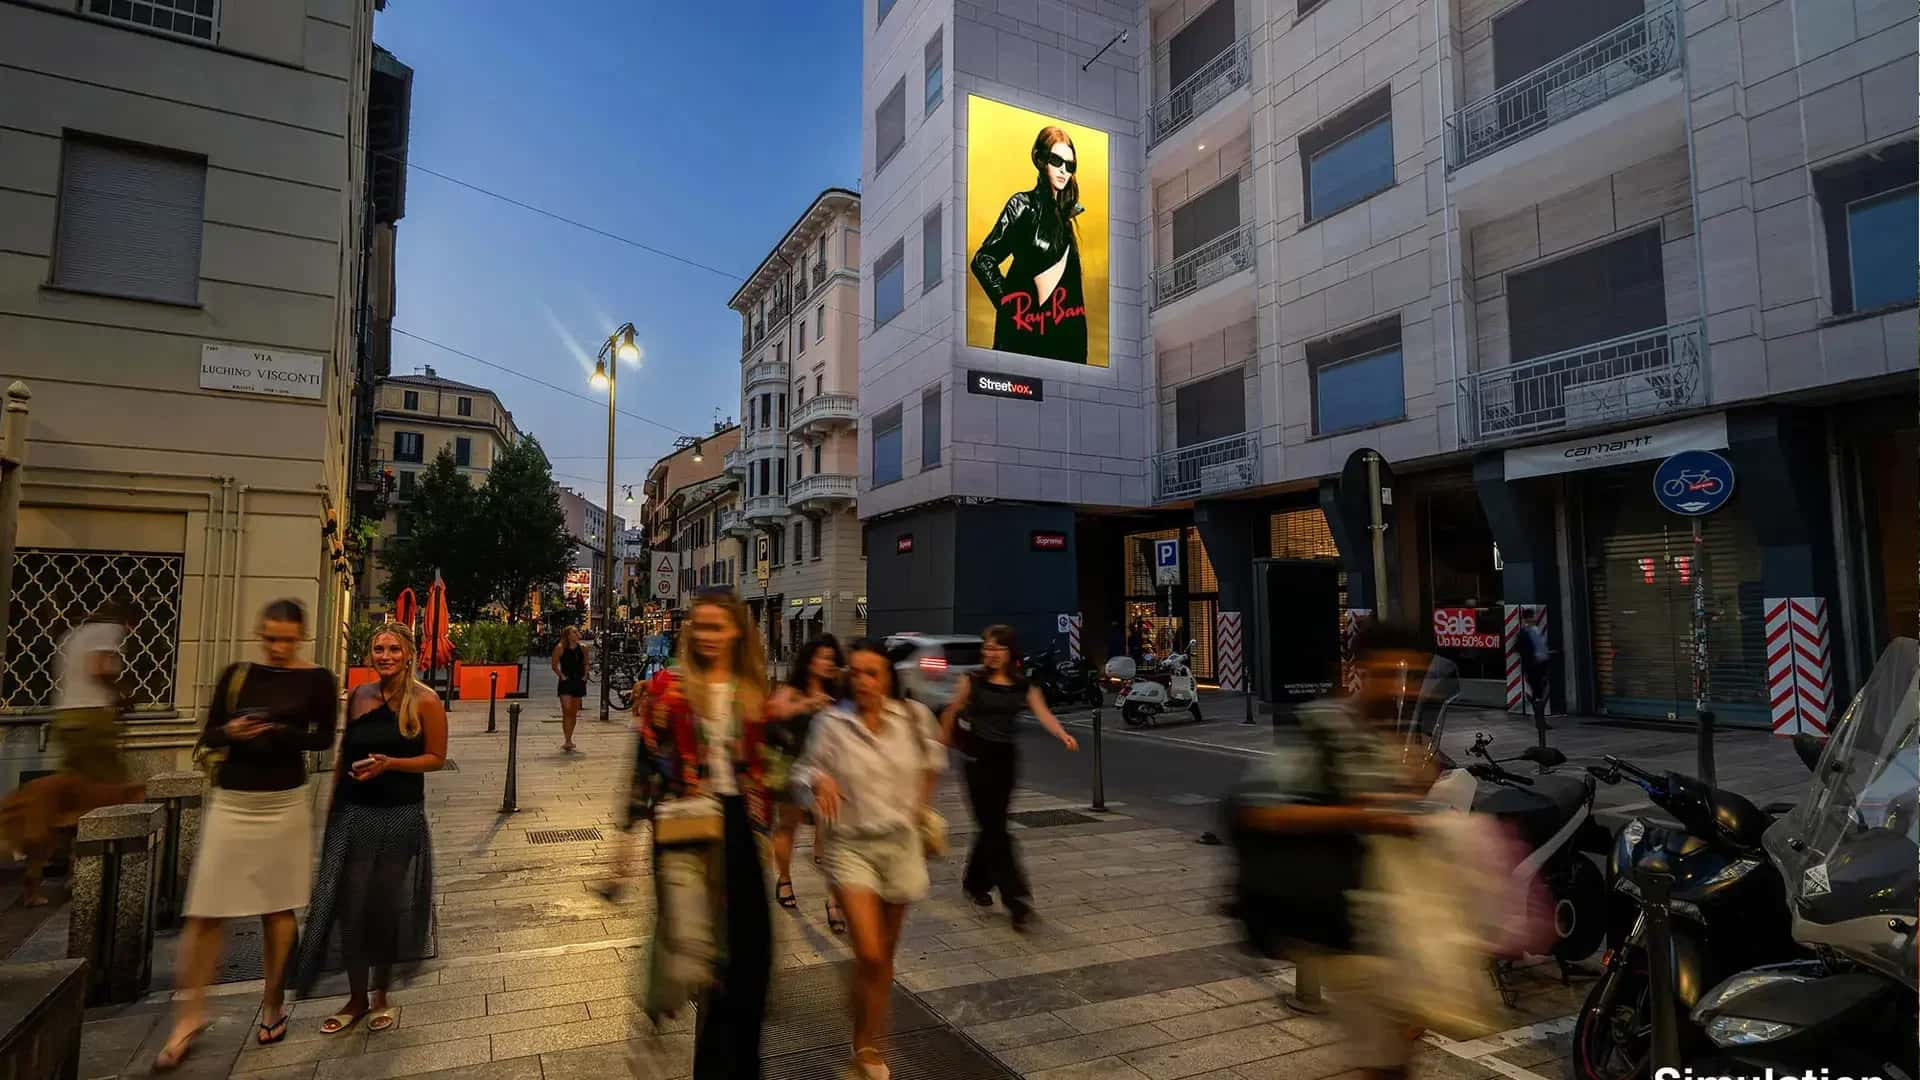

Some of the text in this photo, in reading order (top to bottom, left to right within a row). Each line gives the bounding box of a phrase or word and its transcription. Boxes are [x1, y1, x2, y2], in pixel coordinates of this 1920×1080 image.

[1001, 287, 1086, 335] Ray-Ban
[254, 353, 272, 362] VIA
[202, 365, 320, 385] LUCHINO VISCONTI
[979, 377, 1033, 395] Streetvox.
[1564, 435, 1652, 458] carhartt
[760, 541, 767, 560] P
[1161, 545, 1172, 564] P
[1434, 609, 1475, 635] Sale
[1437, 635, 1450, 648] Up
[1451, 636, 1461, 647] to
[1462, 635, 1484, 648] 50%
